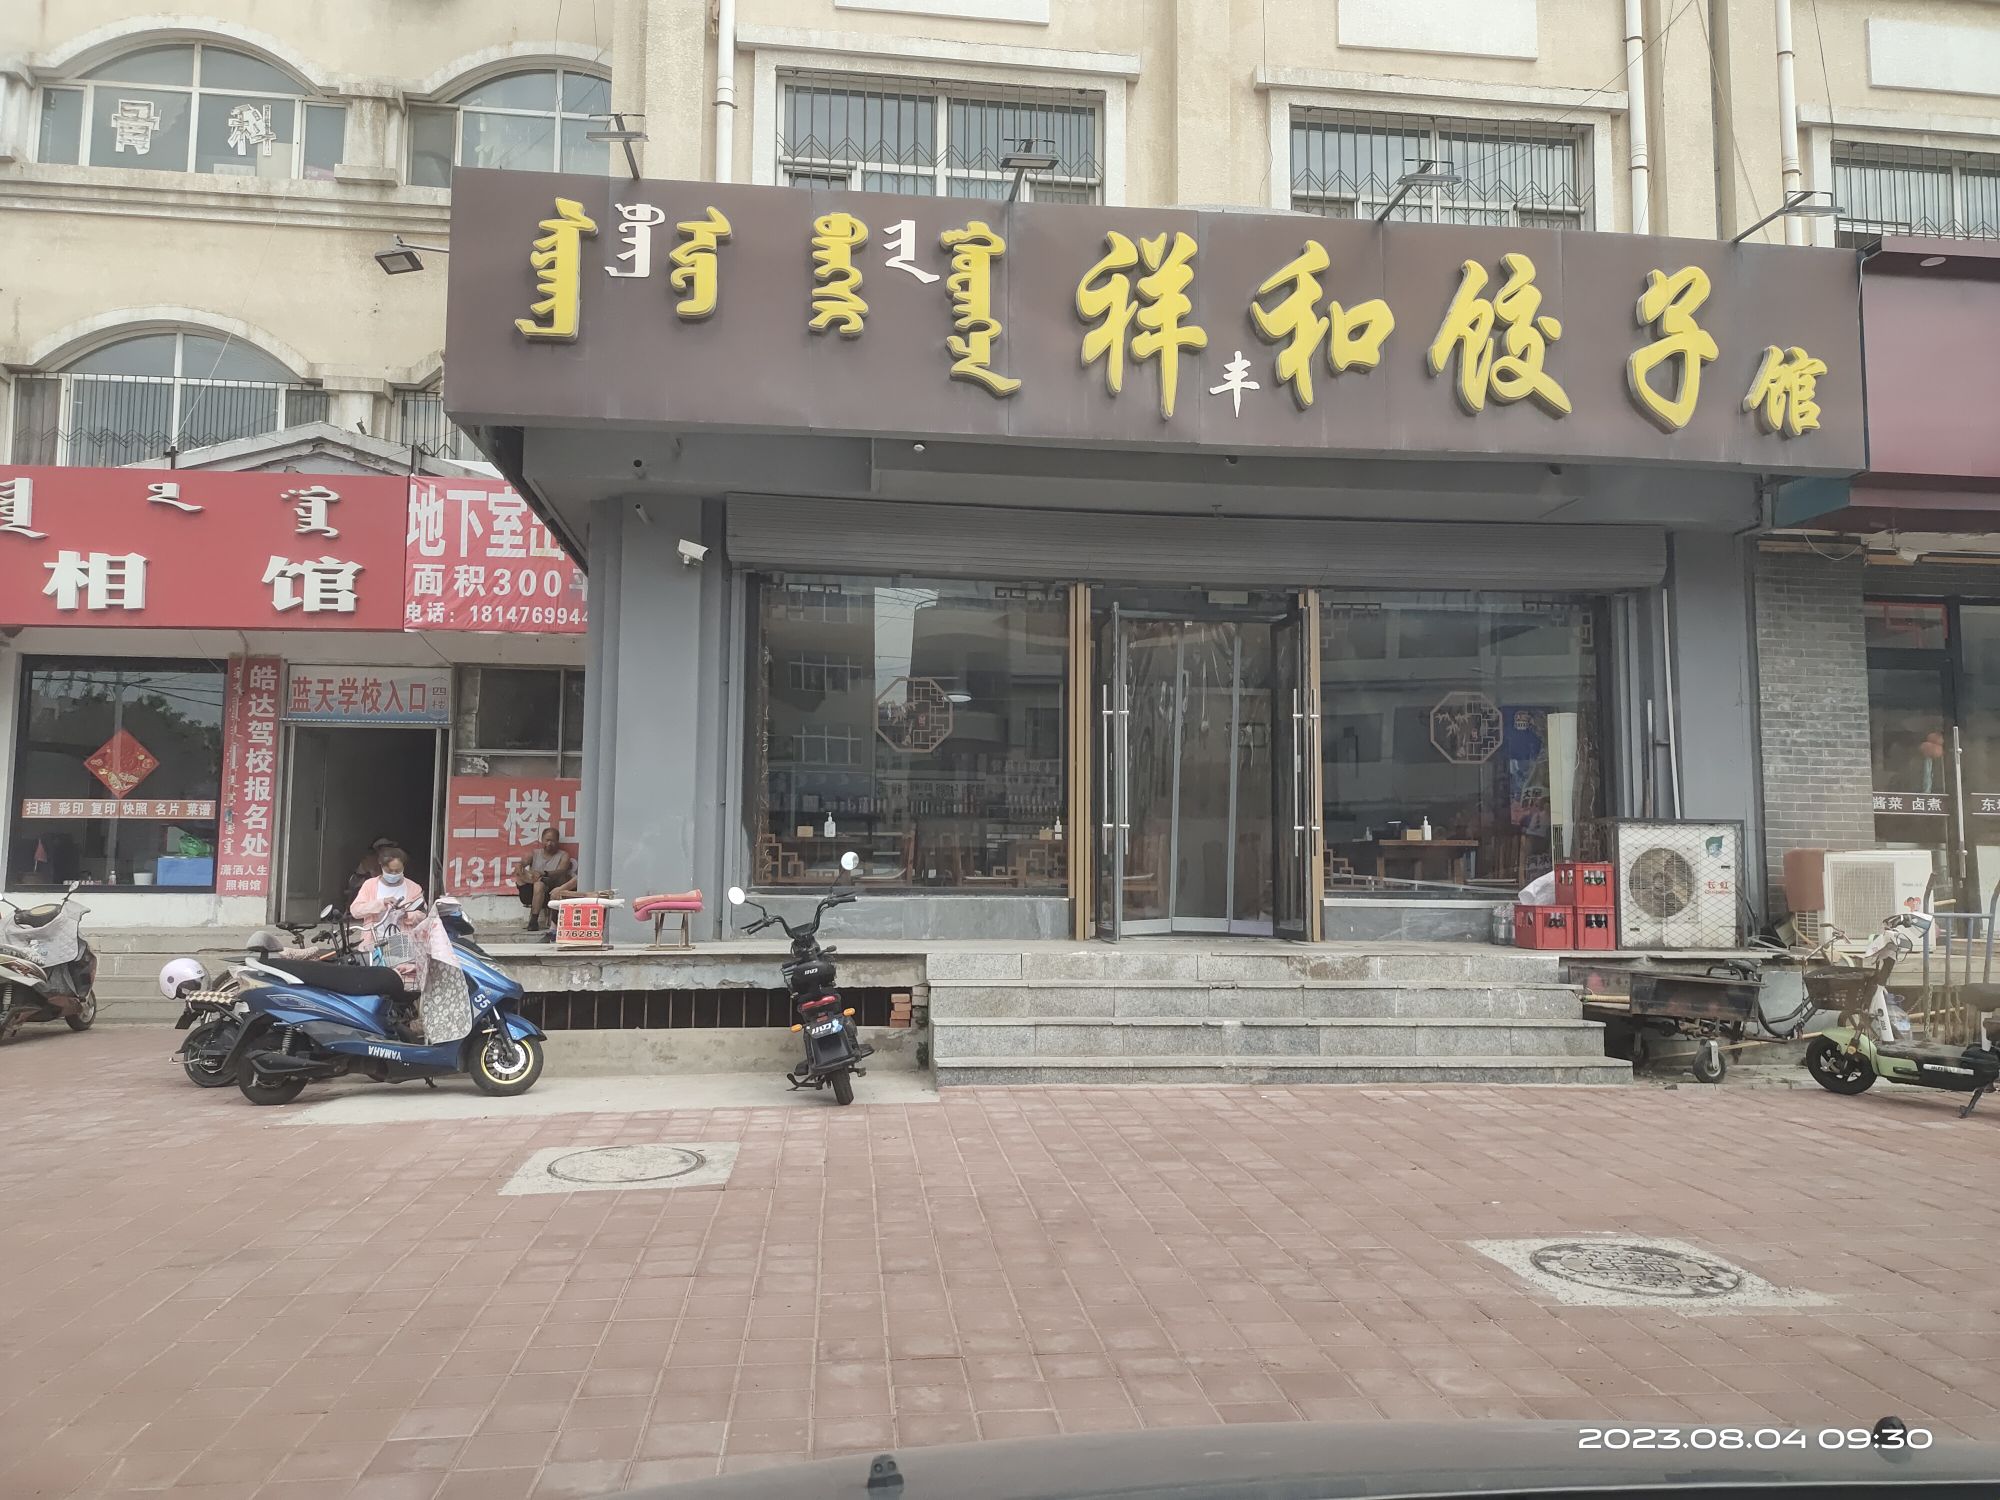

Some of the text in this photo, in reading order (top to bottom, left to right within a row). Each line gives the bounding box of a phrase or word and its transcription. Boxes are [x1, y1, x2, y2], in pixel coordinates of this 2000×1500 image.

[289, 676, 427, 714] 蓝天学校入口
[240, 665, 277, 858] 皓达驾校报名处
[26, 802, 212, 817] 扫描 彩印 复印 快照 名片 菜谱
[1872, 797, 1942, 811] 酱菜 卤煮
[220, 864, 268, 877] 潇洒人生
[225, 879, 262, 892] 照相馆
[474, 993, 492, 1009] 55
[368, 1045, 402, 1061] YAMAHA
